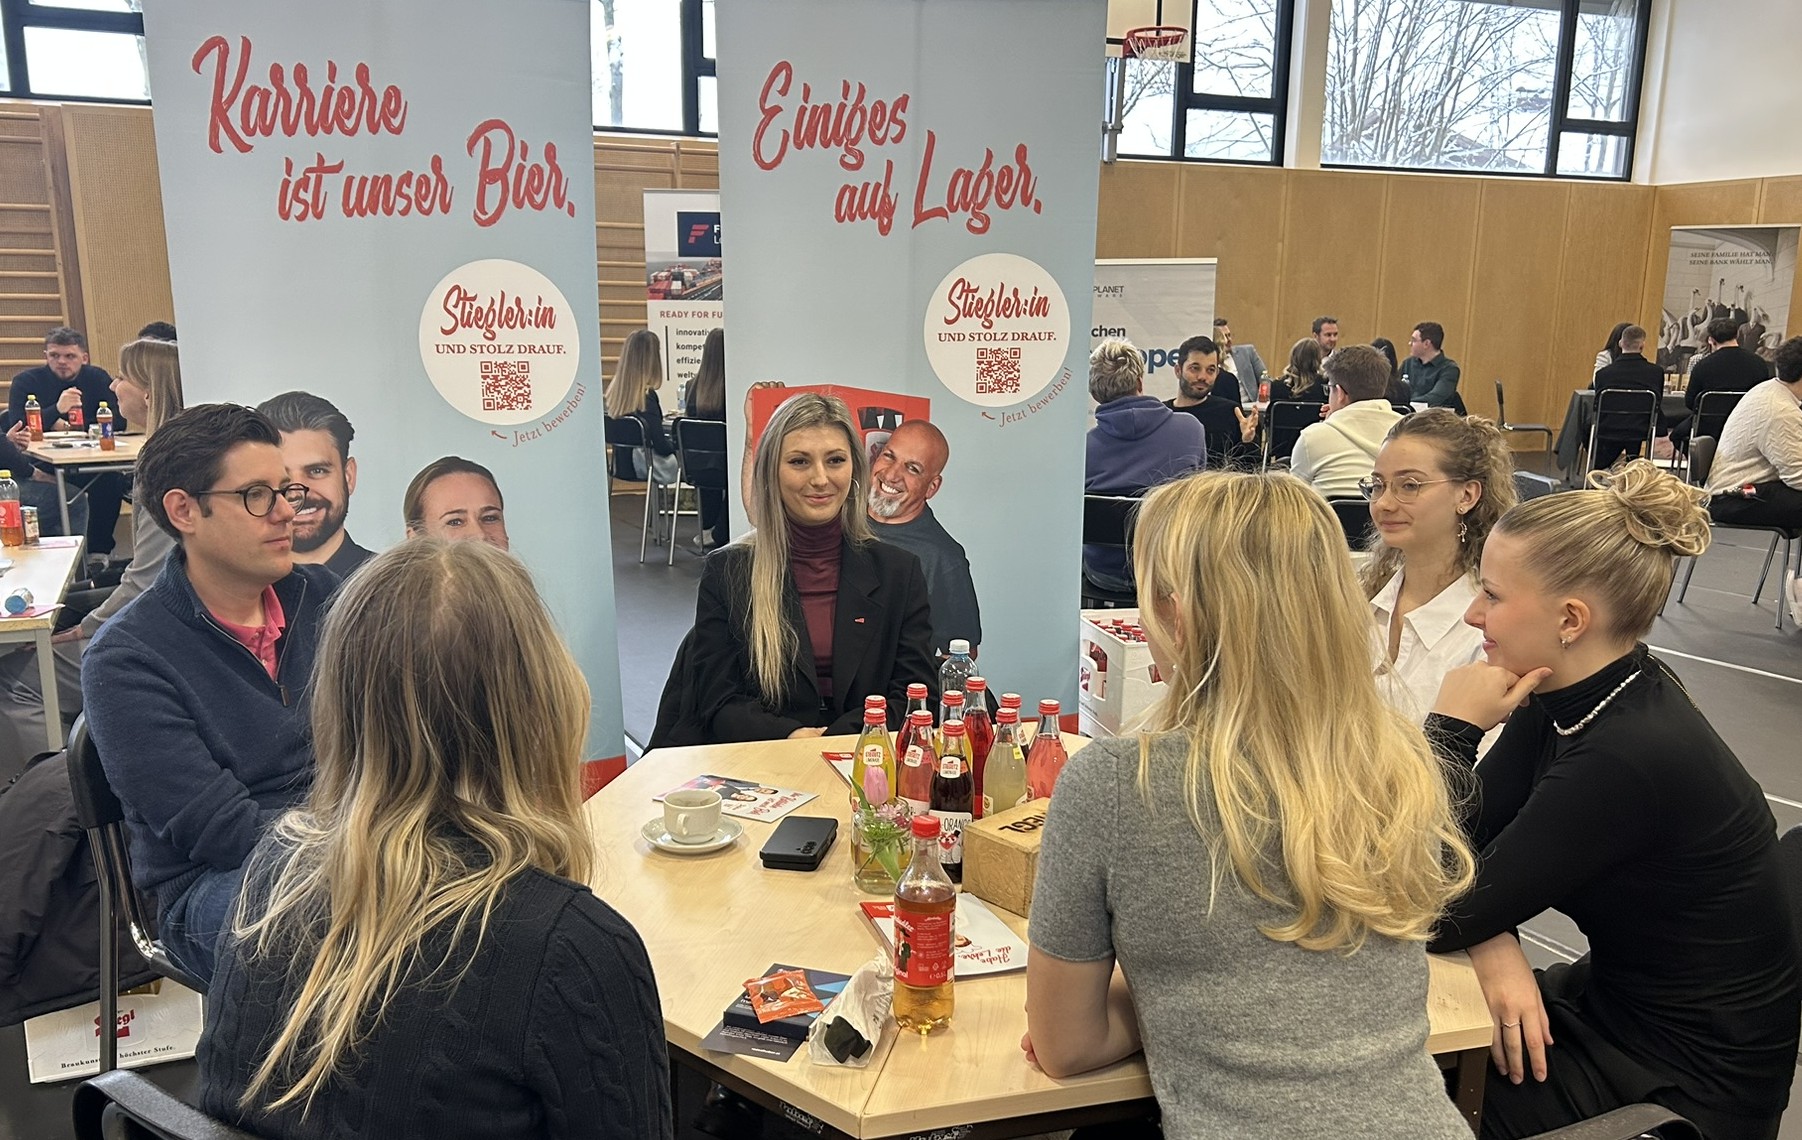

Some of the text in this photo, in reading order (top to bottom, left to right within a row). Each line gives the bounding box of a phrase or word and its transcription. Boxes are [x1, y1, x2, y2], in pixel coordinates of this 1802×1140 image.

[191, 35, 408, 153] Karriere
[752, 60, 910, 171] Einiges
[278, 118, 575, 227] ist unser Bier.
[834, 129, 1043, 237] auf Lager.
[440, 284, 557, 341] Stiegler:in
[660, 310, 688, 318] READY
[691, 311, 709, 319] FOR
[944, 277, 1050, 329] Stiegler:in
[435, 344, 566, 354] UND STOLZ DRAUF.
[938, 331, 1056, 342] UND STOLZ DRAUF.
[512, 382, 587, 447] Jetzt bewerben!
[999, 366, 1073, 427] Jetzt bewerben!
[119, 1049, 151, 1058] höchster
